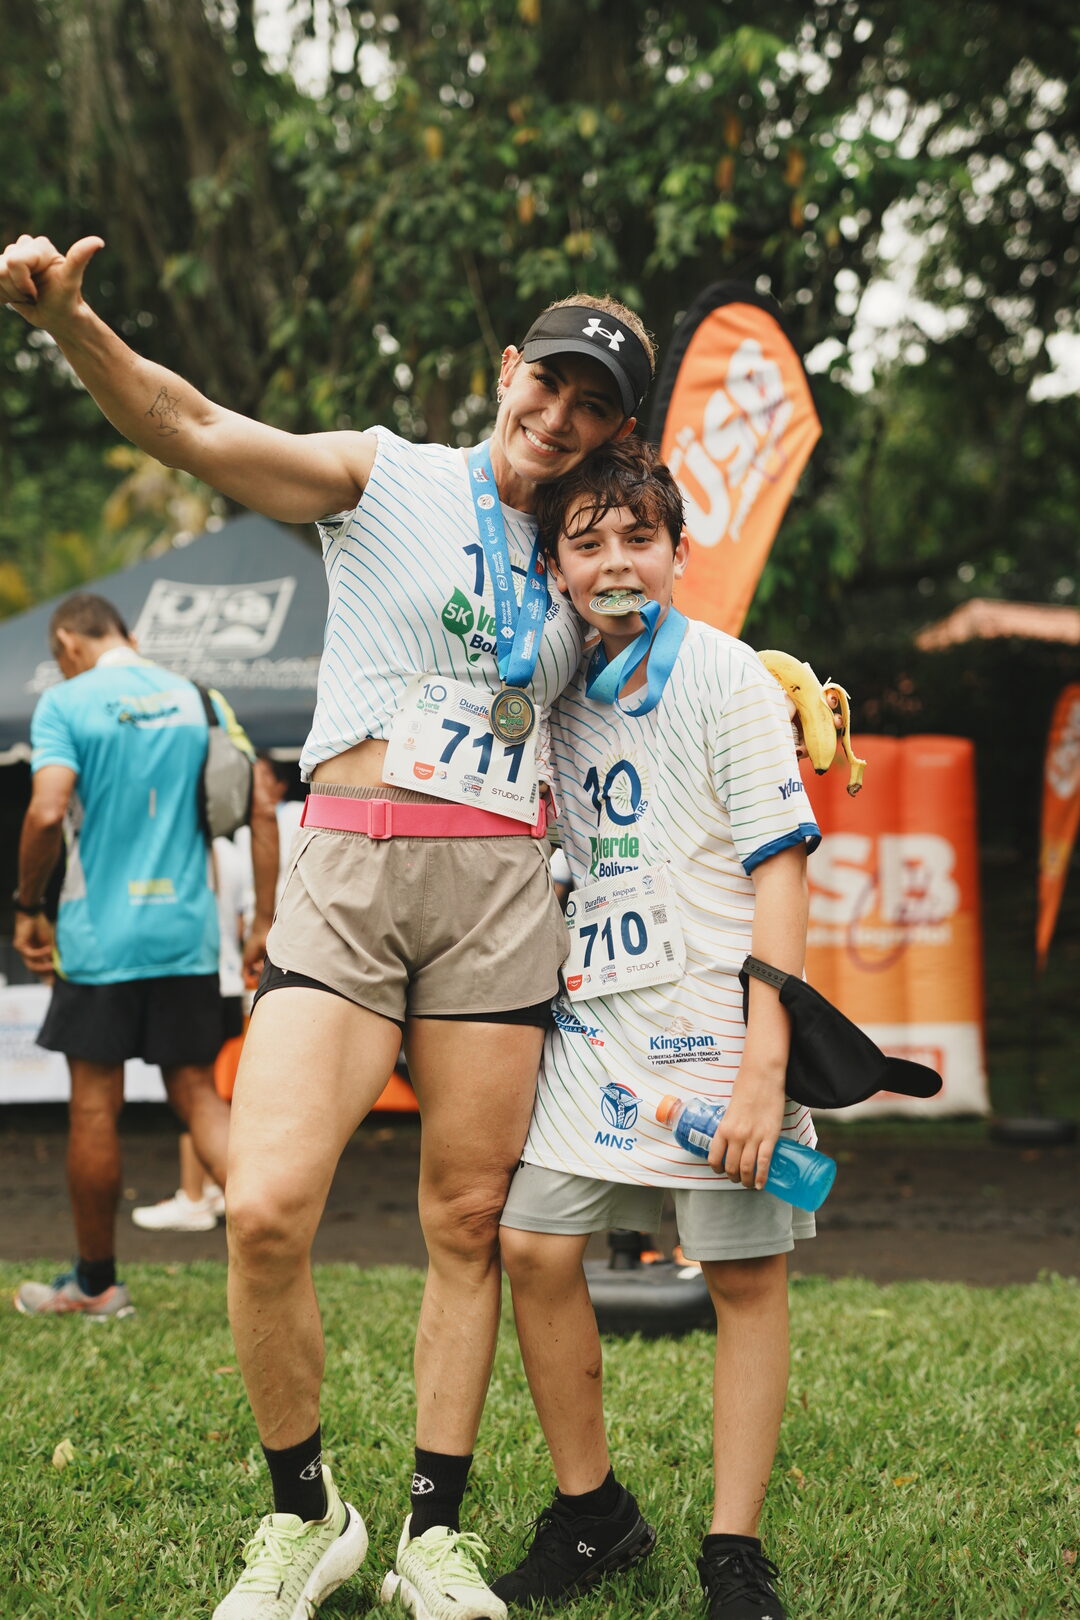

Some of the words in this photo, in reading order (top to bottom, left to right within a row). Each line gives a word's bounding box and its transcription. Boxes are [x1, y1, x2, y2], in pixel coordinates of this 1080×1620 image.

[444, 602, 472, 626] 5K
[544, 602, 560, 624] EARS
[423, 683, 447, 702] 10
[459, 698, 489, 716] Durafle
[439, 718, 526, 784] 711
[491, 787, 519, 801] STUDIO
[583, 759, 642, 827] 10
[634, 799, 649, 821] ARS
[807, 832, 961, 924] SB
[612, 886, 636, 898] Kingspan
[584, 895, 607, 910] Duraflex
[579, 911, 648, 969] 710
[626, 962, 655, 974] STUDIO
[650, 1035, 715, 1052] Kingspan
[594, 1131, 635, 1151] MNS
